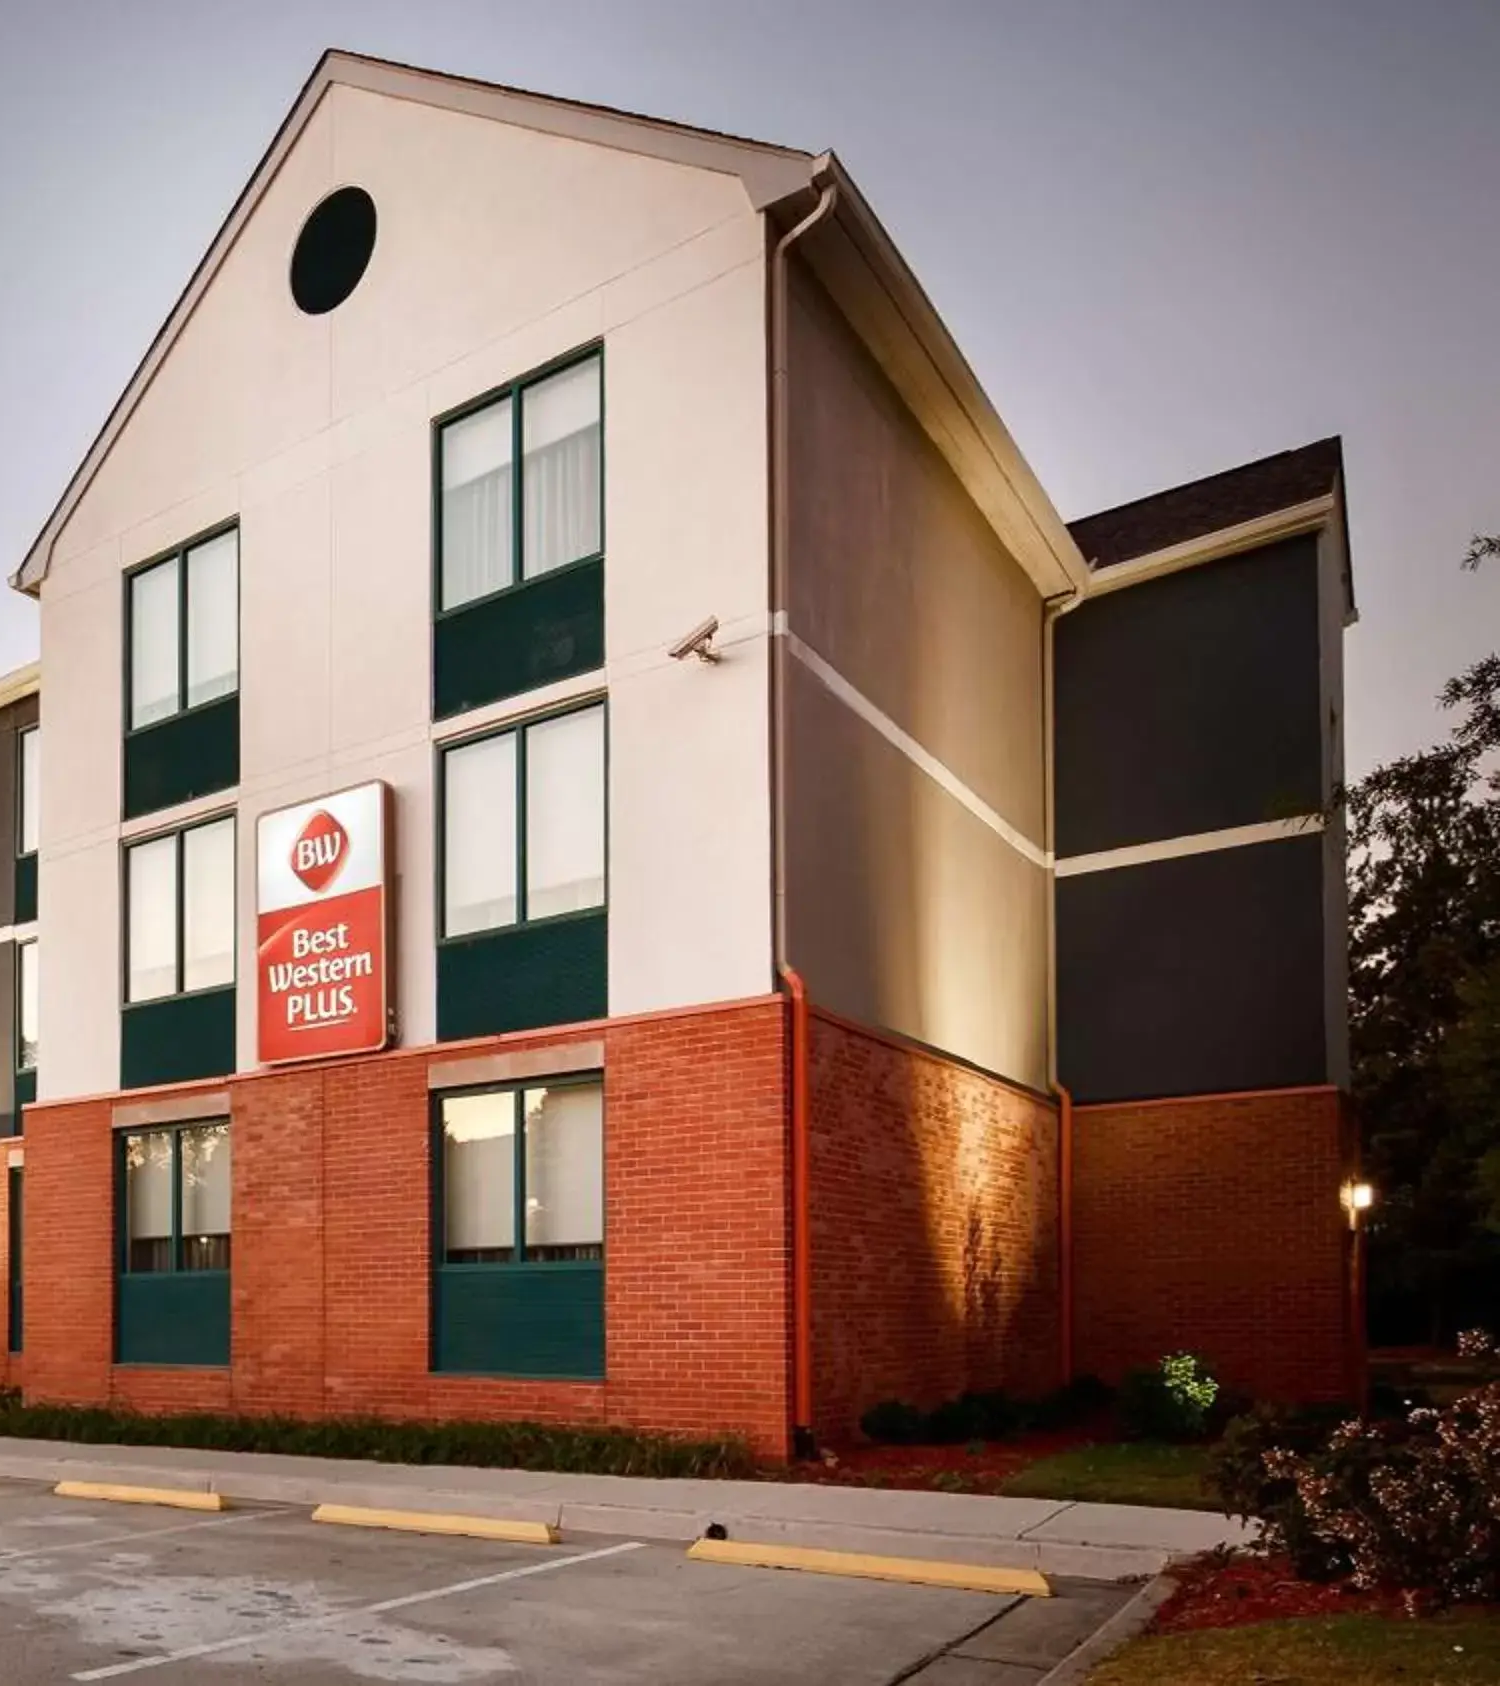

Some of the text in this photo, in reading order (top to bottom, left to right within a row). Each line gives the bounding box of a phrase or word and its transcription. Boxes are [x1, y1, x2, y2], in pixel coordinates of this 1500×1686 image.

[297, 833, 341, 870] BW
[292, 923, 349, 956] Best
[268, 952, 372, 992] Western
